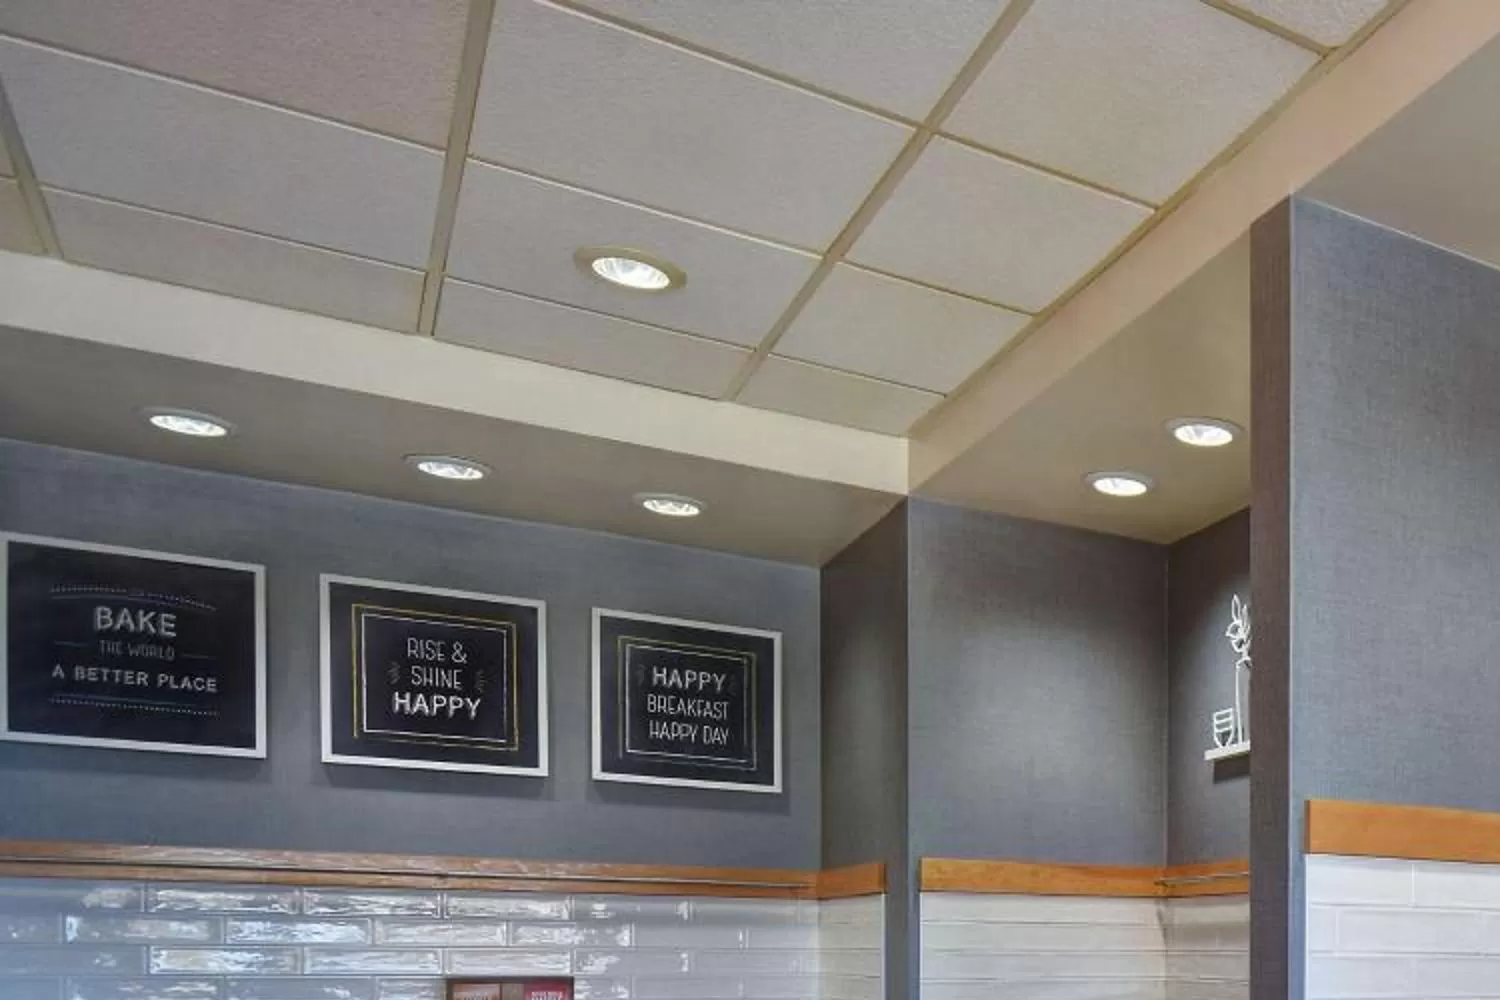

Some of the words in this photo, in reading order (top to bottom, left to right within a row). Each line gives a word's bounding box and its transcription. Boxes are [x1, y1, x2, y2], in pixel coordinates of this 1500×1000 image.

[94, 605, 177, 637] BAKE
[100, 639, 122, 656] THE
[128, 643, 175, 662] WORLD
[407, 637, 445, 662] RISE
[451, 641, 467, 664] &
[52, 664, 65, 679] A
[74, 665, 149, 687] BETTER
[157, 673, 217, 693] PLACE
[411, 665, 462, 690] SHINE
[652, 665, 727, 694] HAPPY
[394, 691, 481, 720] HAPPY
[647, 693, 729, 720] BREAKFAST
[649, 719, 699, 744] HAPPY
[703, 725, 729, 745] DAY
